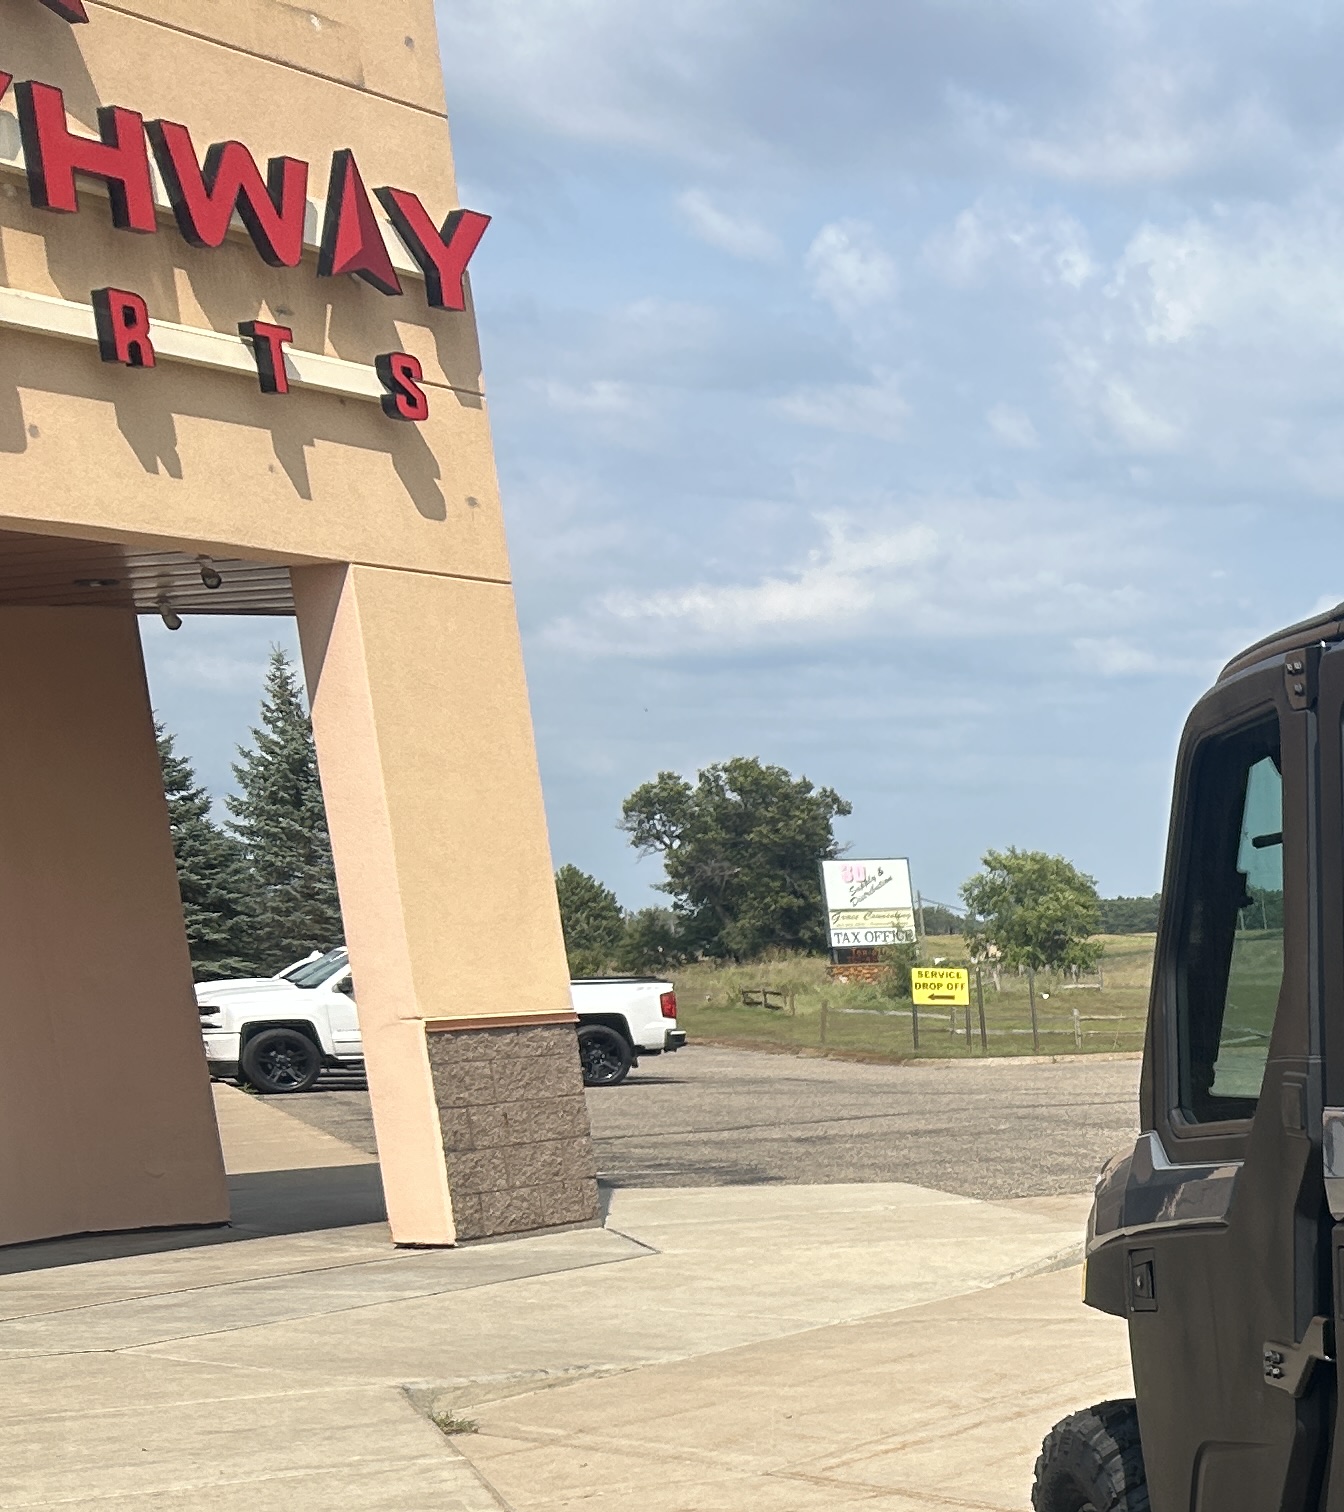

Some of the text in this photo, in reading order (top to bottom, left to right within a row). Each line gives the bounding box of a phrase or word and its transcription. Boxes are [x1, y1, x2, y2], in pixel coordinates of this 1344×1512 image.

[0, 72, 491, 312] HWAY
[834, 932, 861, 944] TAX
[918, 971, 962, 979] SERVICE
[915, 982, 965, 991] DROP OFF
